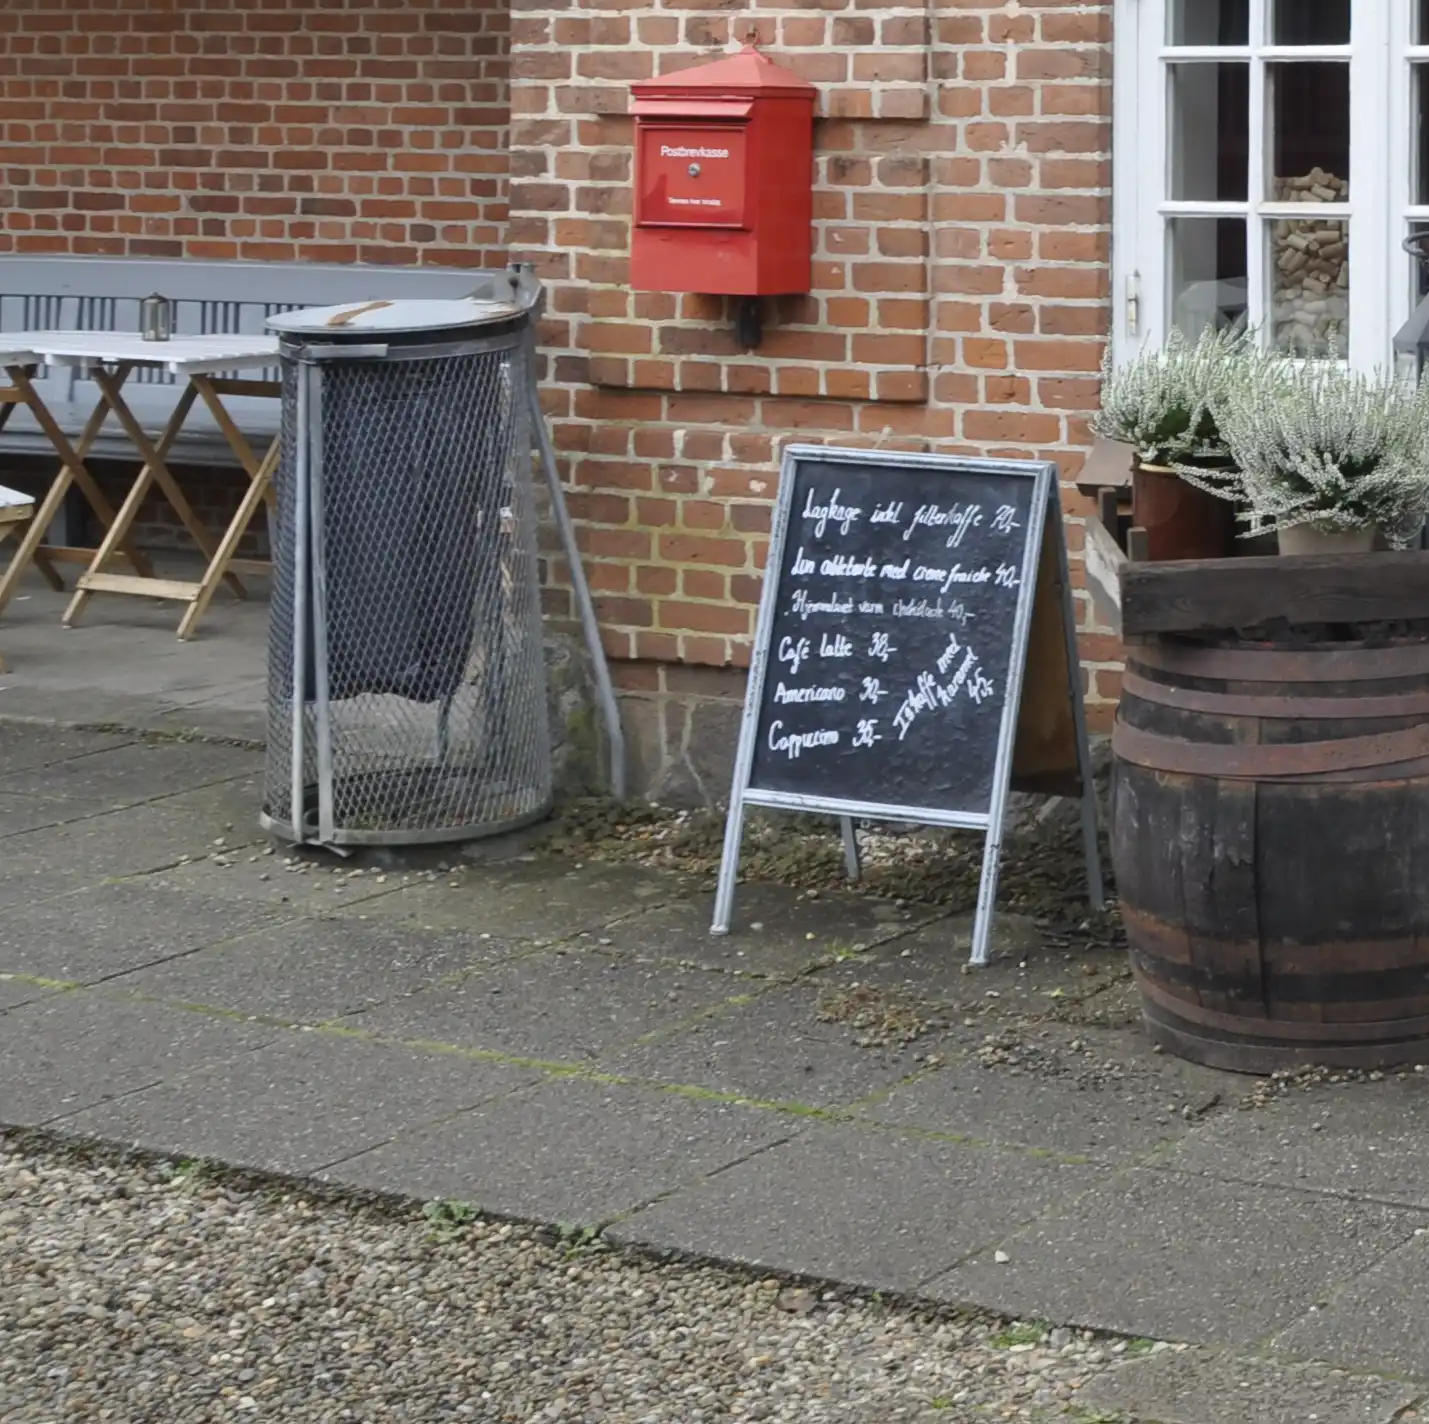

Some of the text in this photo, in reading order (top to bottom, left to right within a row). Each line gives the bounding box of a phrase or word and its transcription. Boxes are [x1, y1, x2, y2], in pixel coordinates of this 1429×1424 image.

[660, 145, 729, 158] Postbrevkasse
[802, 487, 862, 538] Lagkage
[879, 558, 911, 580] med
[778, 635, 811, 675] Café
[773, 681, 846, 705] Americano
